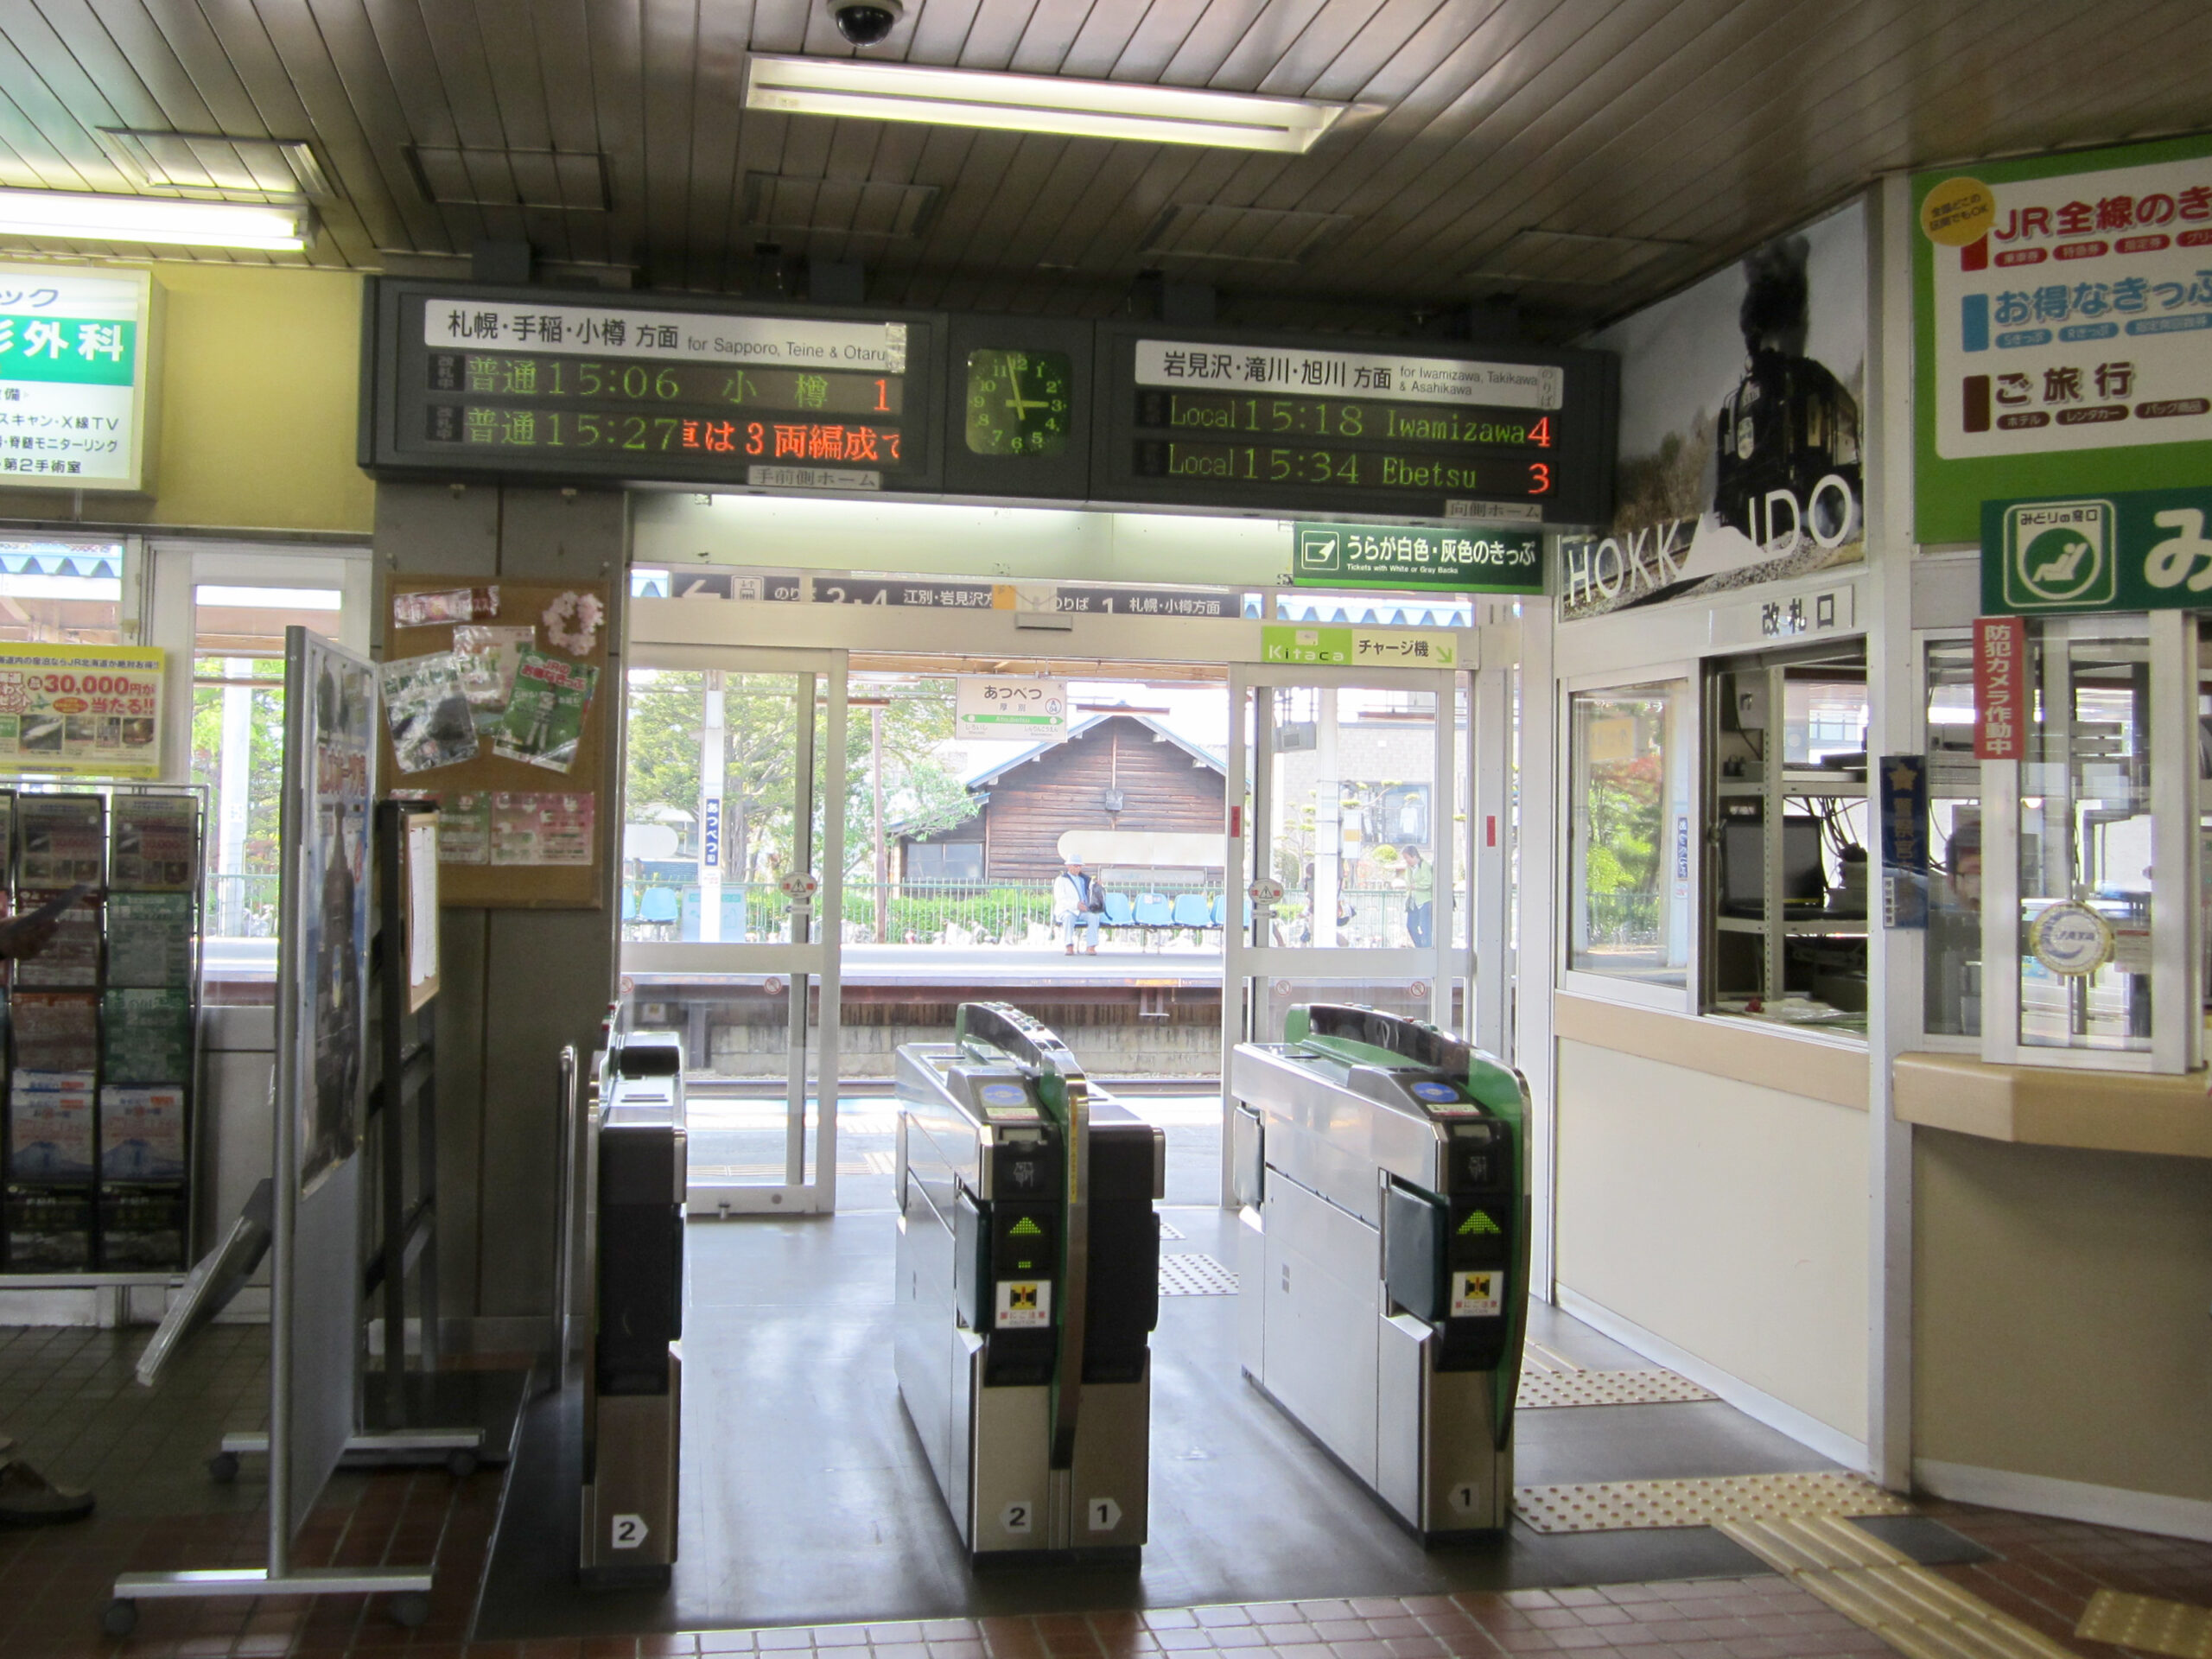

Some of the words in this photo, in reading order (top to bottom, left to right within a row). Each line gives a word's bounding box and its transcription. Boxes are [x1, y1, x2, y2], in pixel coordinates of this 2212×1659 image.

[688, 336, 708, 351] for
[714, 338, 779, 357] Sapporo,
[786, 342, 823, 357] Teine
[830, 346, 837, 358] &
[844, 346, 886, 360] Otaru
[467, 357, 537, 395] 普通
[549, 362, 679, 399] 15:06
[874, 379, 890, 411] 1
[1401, 365, 1414, 378] for
[1421, 367, 1483, 383] Iwamizawa,
[1488, 371, 1537, 385] Takikawa
[981, 380, 996, 392] 10
[1046, 381, 1058, 393] 2
[1400, 381, 1406, 391] &
[1412, 381, 1471, 395] Asahikawa
[974, 396, 985, 408] 9
[1052, 399, 1062, 411] 3
[467, 408, 537, 445] 普通
[548, 414, 677, 450] 15:27
[978, 414, 989, 426] 8
[1046, 418, 1057, 429] 4
[1171, 395, 1236, 428] Local
[1245, 400, 1363, 436] 15:18
[1387, 410, 1525, 444] Iwamizawa
[1528, 416, 1551, 448] 4
[992, 429, 1003, 442] 7
[1011, 437, 1023, 449] 6
[1032, 432, 1043, 443] 5
[757, 467, 875, 487] 手前側ホーム
[1169, 443, 1234, 475] Local
[1244, 448, 1359, 484] 15:34
[1382, 457, 1476, 489] Ebetsu
[1528, 463, 1550, 494] 3
[1347, 535, 1535, 566] うらが白色・灰色のきっぷ
[1389, 564, 1409, 573] White
[1129, 597, 1220, 614] 札幌・小樽方面
[1762, 594, 1834, 635] 改札口
[1268, 645, 1344, 661] Kitaca
[1358, 639, 1429, 657] チャージ機
[984, 685, 1042, 700] あつべつ
[1985, 625, 2012, 754] 防犯カメラ作動中
[707, 802, 717, 853] あつべつ
[1461, 1488, 1471, 1507] 1
[1009, 1507, 1027, 1527] 2
[1097, 1504, 1107, 1523] 1
[619, 1521, 636, 1541] 2
